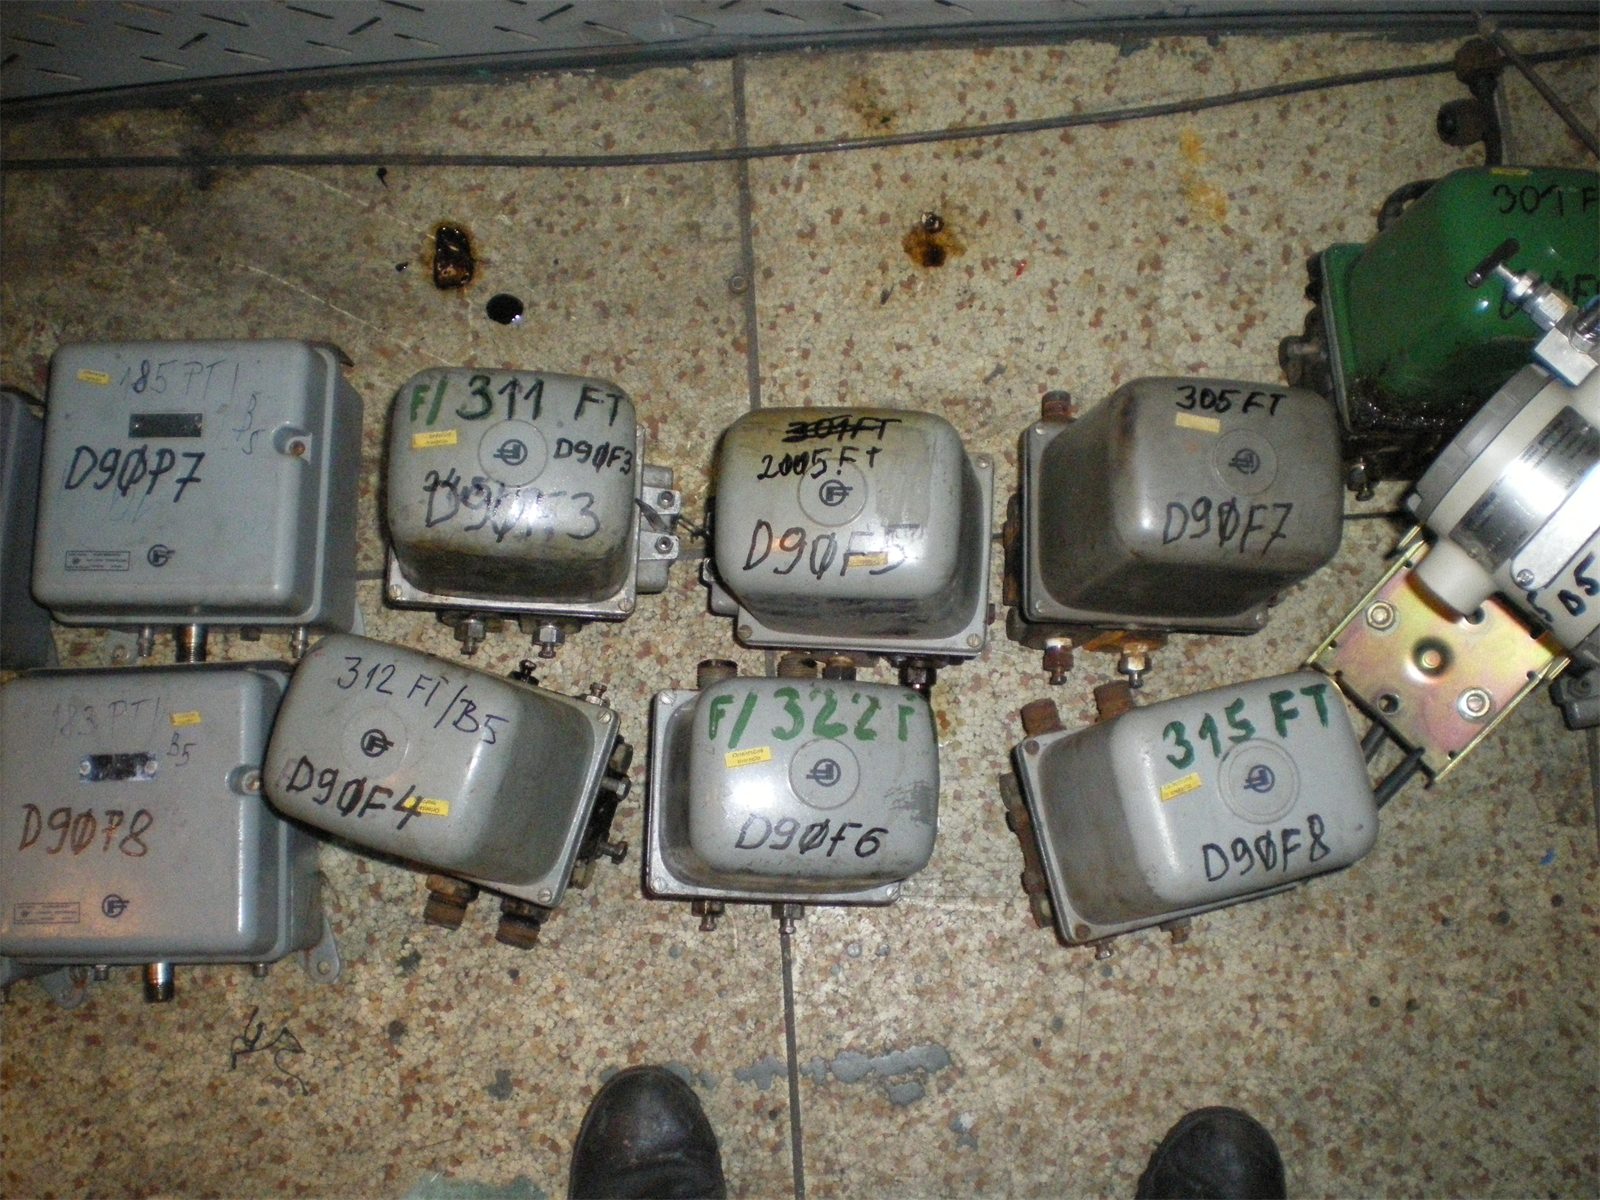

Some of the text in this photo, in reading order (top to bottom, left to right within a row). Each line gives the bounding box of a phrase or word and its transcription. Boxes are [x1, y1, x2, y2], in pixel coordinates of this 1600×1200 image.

[1493, 184, 1564, 216] 301
[456, 374, 544, 420] 311
[574, 385, 625, 426] FT
[337, 657, 395, 695] 312
[1163, 683, 1329, 769] 315 FT
